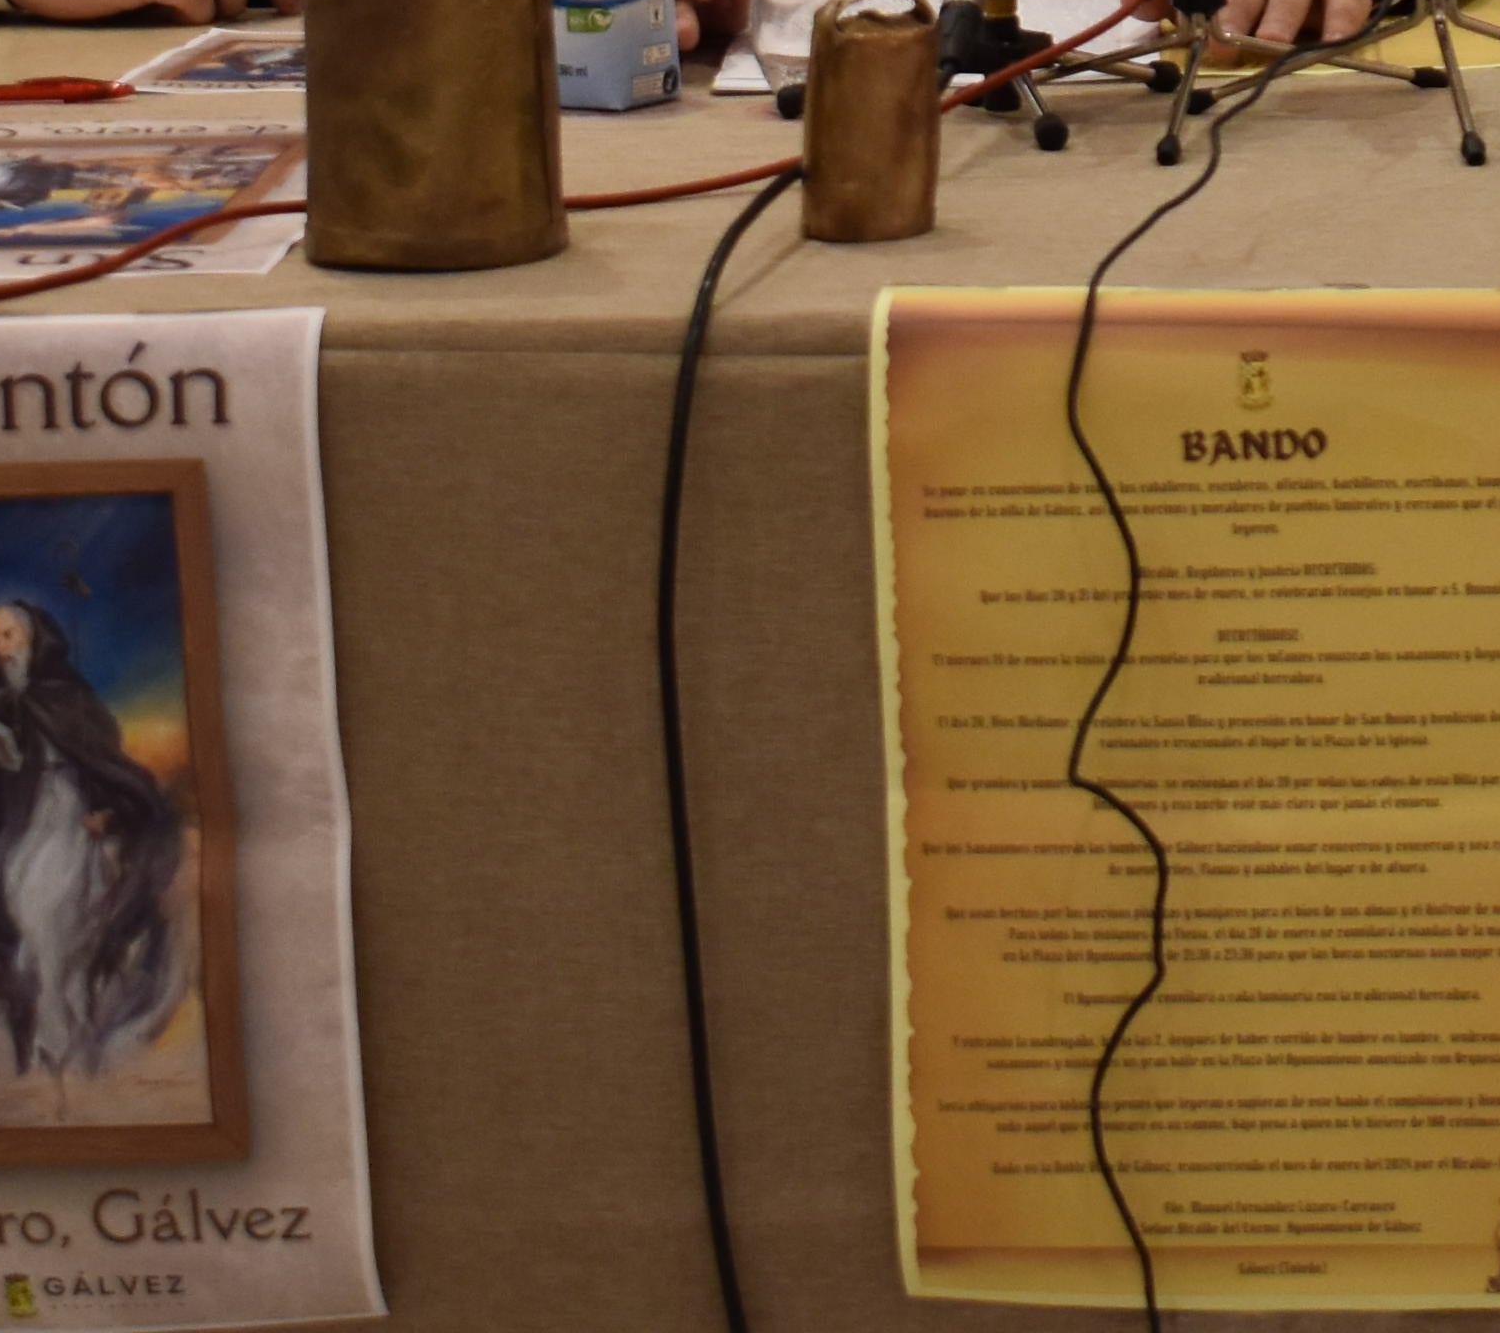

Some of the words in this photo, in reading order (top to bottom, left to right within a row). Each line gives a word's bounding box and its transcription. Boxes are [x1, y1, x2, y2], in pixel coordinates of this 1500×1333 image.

[1181, 427, 1328, 465] BANDO
[90, 1187, 313, 1246] Gálvez
[42, 1269, 189, 1299] GÁLVEZ
